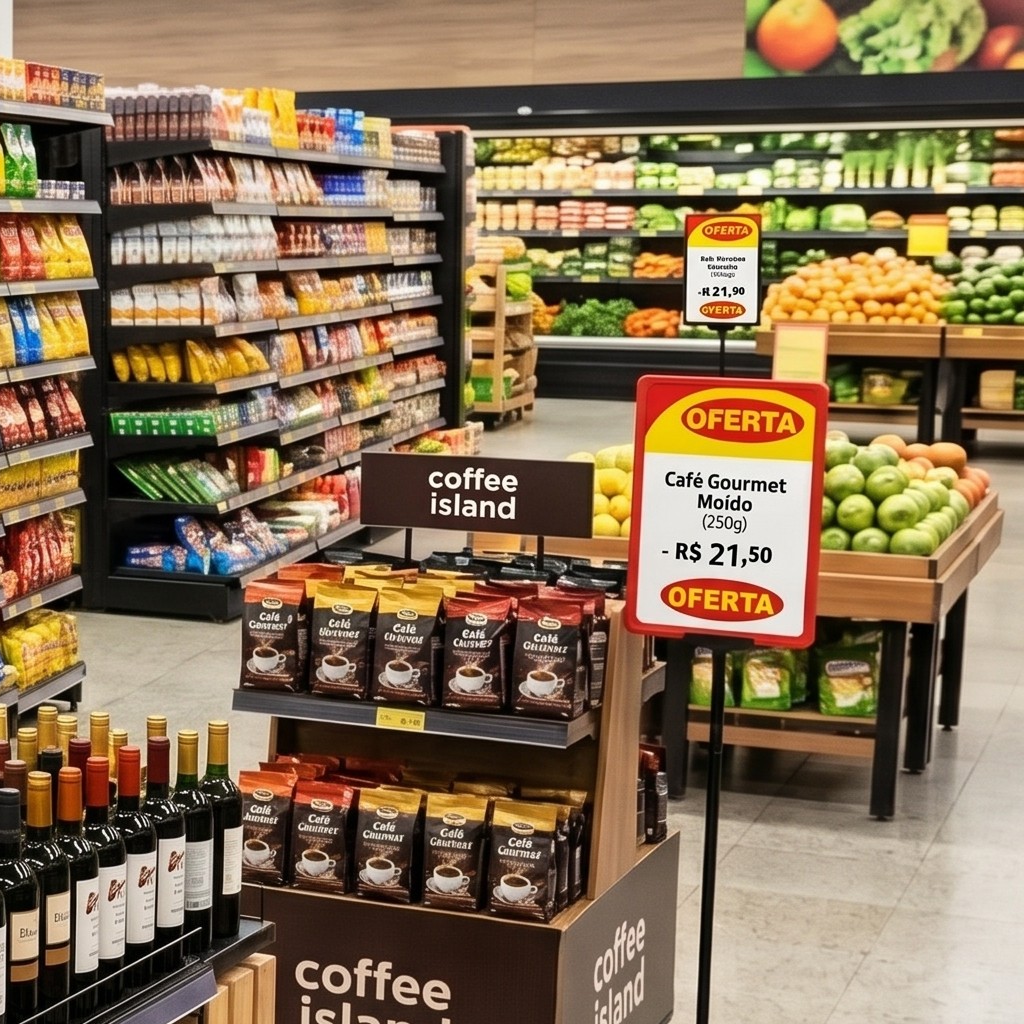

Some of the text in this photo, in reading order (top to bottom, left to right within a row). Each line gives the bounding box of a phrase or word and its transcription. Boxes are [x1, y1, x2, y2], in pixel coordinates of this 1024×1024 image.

[704, 225, 749, 236] OFERTA
[712, 286, 745, 298] 21,90
[686, 408, 797, 434] OFERTA
[428, 467, 519, 493] coffee
[665, 471, 787, 493] Café Gourmet
[430, 492, 517, 520] island
[697, 493, 753, 512] Moído
[702, 514, 747, 534] (250g)
[675, 541, 702, 563] R$
[709, 543, 772, 568] 21,50
[668, 586, 775, 615] OFERTA
[593, 918, 645, 993] coffee
[295, 958, 451, 1011] coffee
